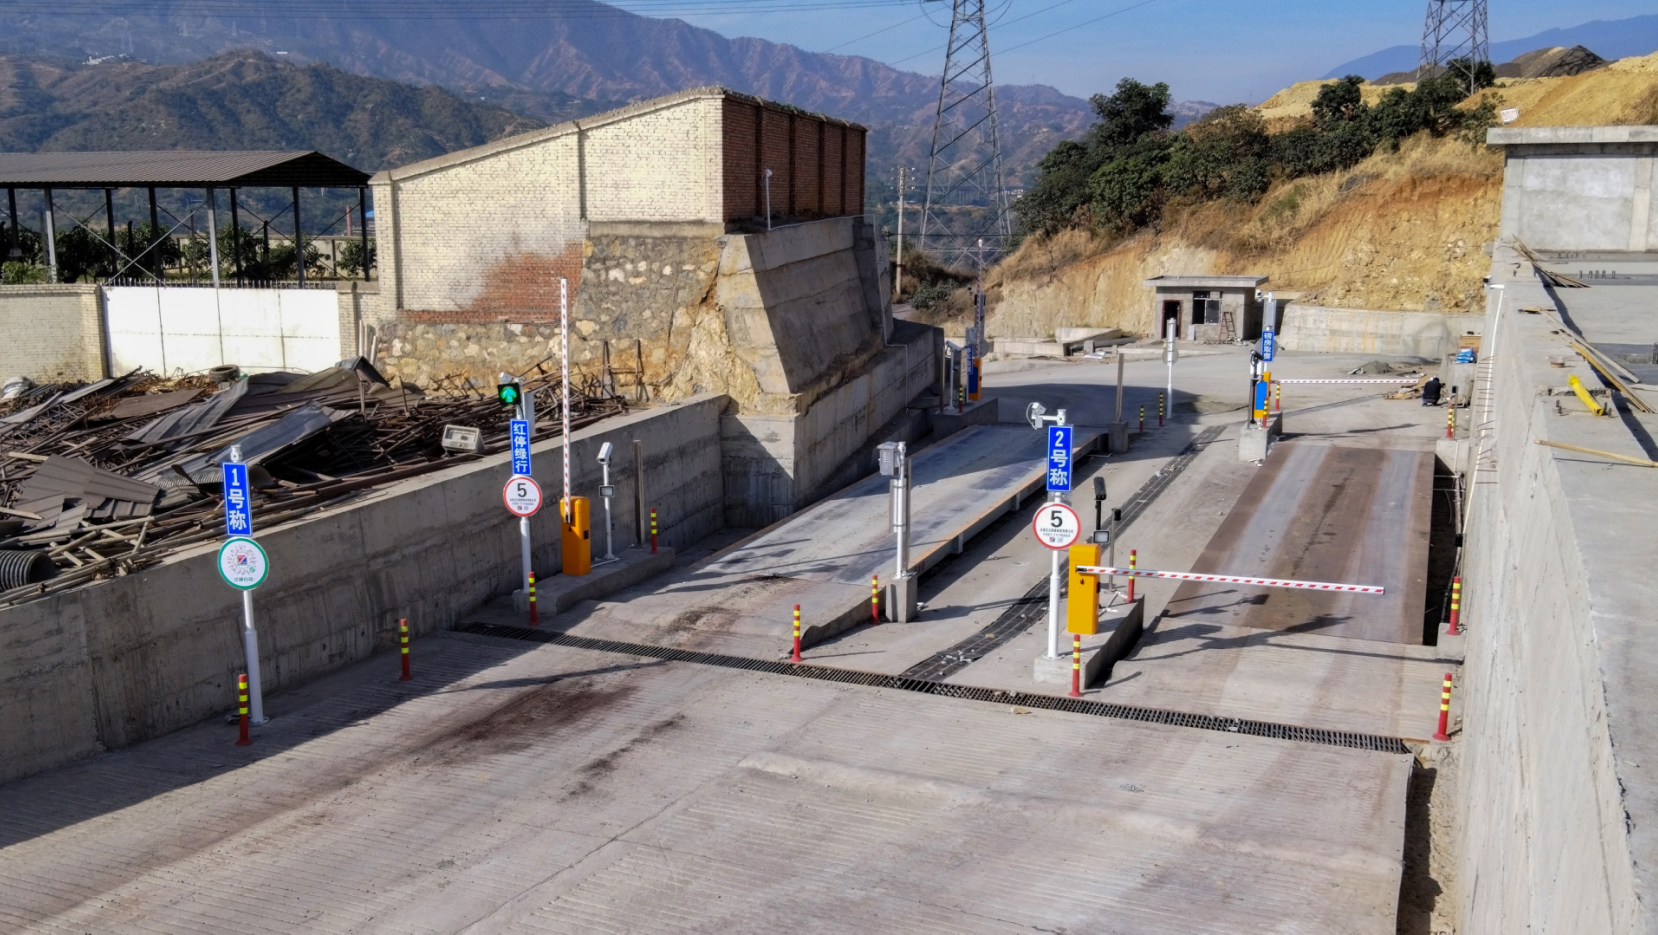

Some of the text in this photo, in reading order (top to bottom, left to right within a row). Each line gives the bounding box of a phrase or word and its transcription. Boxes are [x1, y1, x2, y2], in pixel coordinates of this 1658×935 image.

[513, 423, 528, 472] 红停绿行
[1050, 431, 1068, 485] 2号称
[228, 468, 247, 530] 1号称
[517, 482, 527, 498] 5
[1050, 510, 1063, 528] 5
